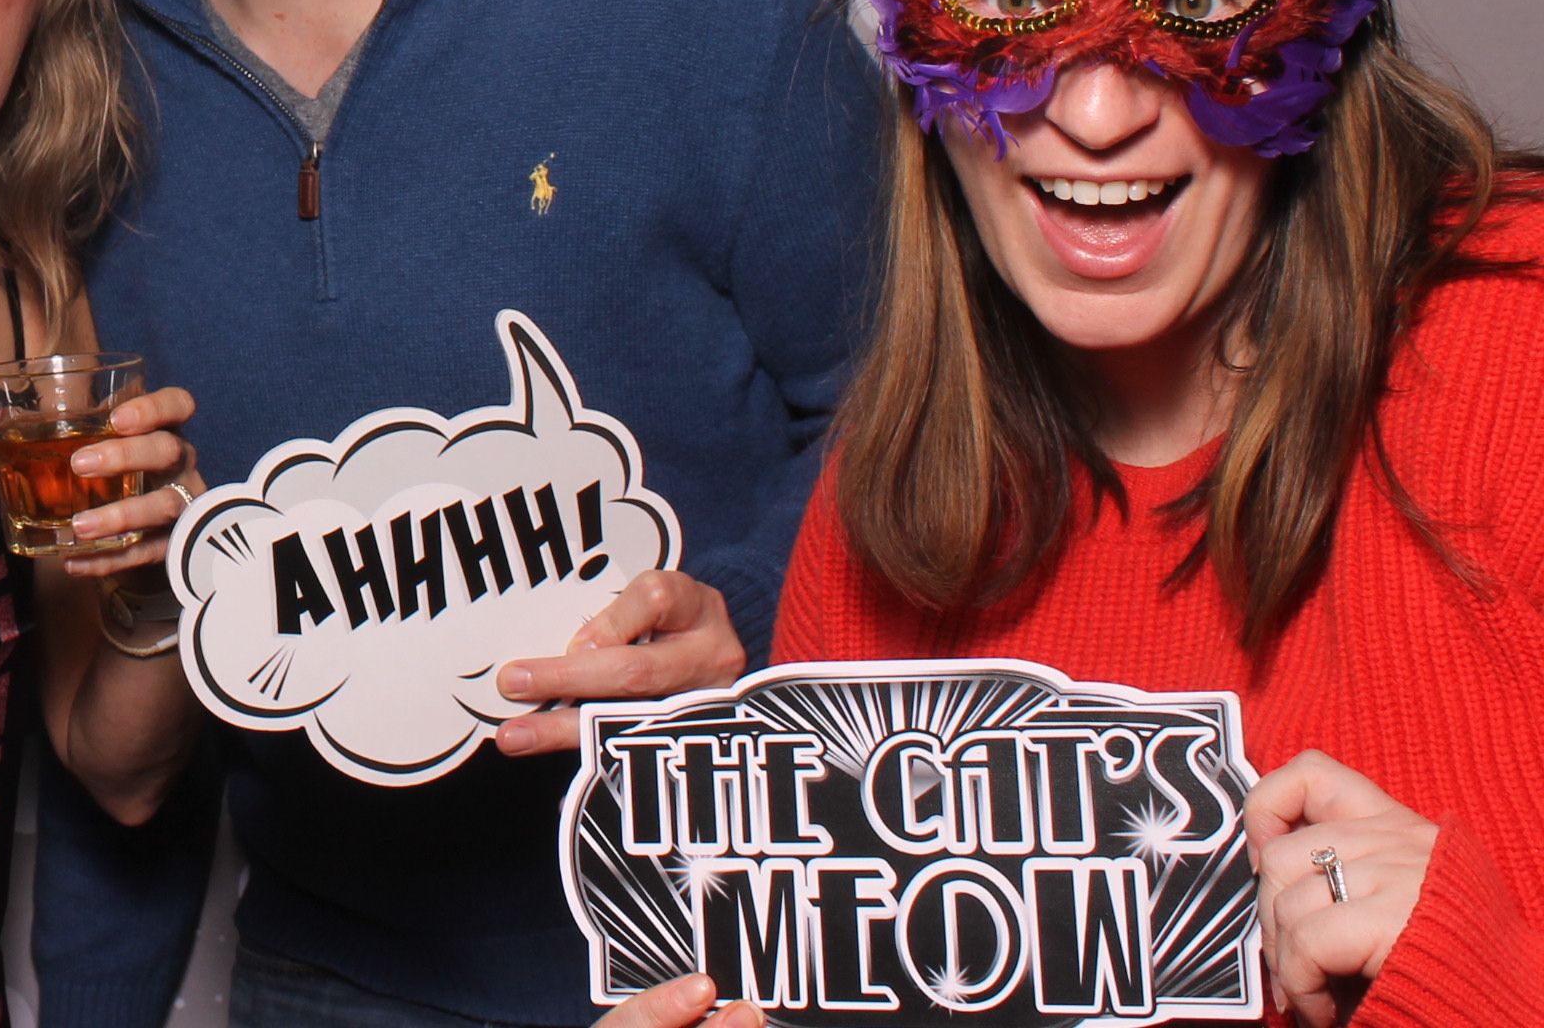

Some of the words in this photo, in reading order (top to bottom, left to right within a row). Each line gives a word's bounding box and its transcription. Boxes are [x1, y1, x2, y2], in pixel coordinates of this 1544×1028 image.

[271, 480, 610, 635] AHHHH!
[605, 733, 833, 854] THE
[860, 727, 1236, 854] CAT'S
[690, 857, 1153, 1015] MEOW
